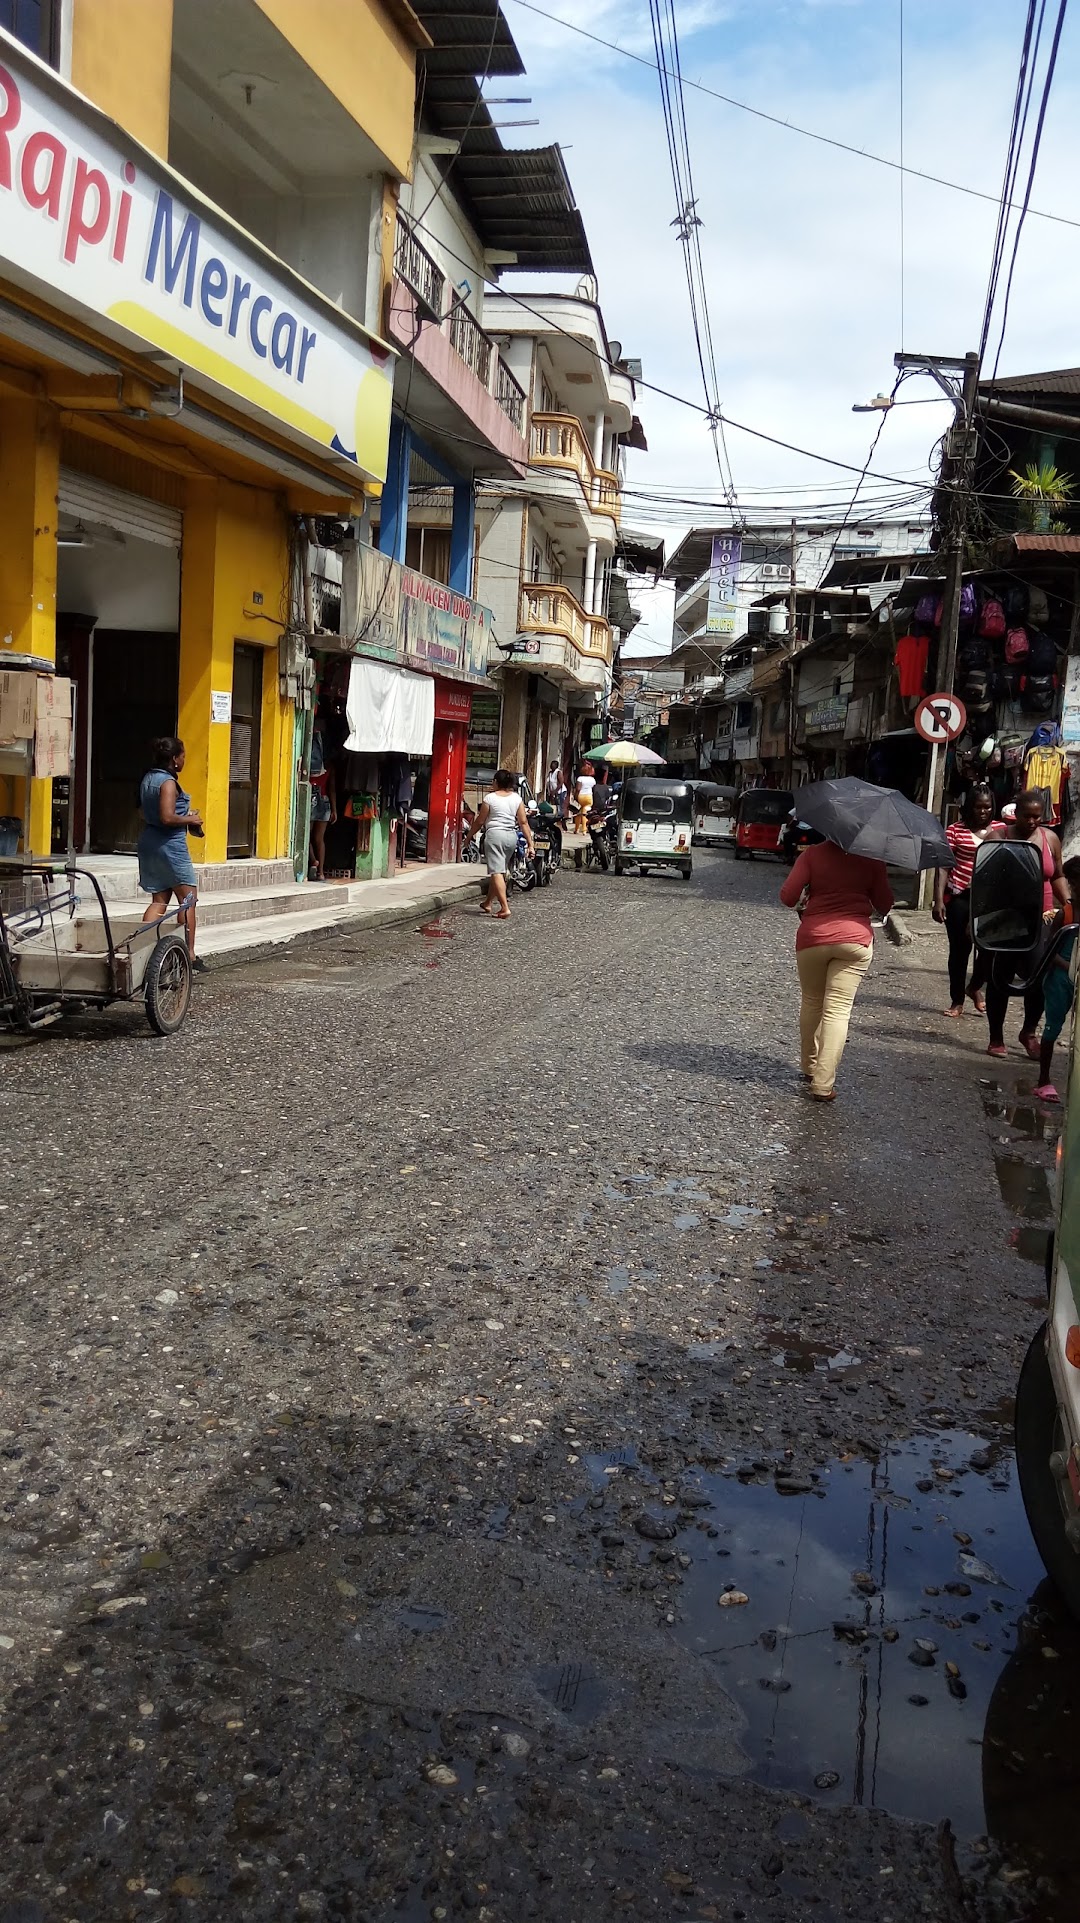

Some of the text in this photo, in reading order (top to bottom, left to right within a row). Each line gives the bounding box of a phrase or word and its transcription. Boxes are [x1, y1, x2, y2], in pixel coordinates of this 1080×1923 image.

[0, 63, 317, 384] Rapi Mercar
[401, 571, 451, 613] ALMACEN
[452, 596, 472, 622] UNO
[478, 607, 485, 628] A
[718, 539, 733, 602] Hotel
[932, 706, 951, 732] P
